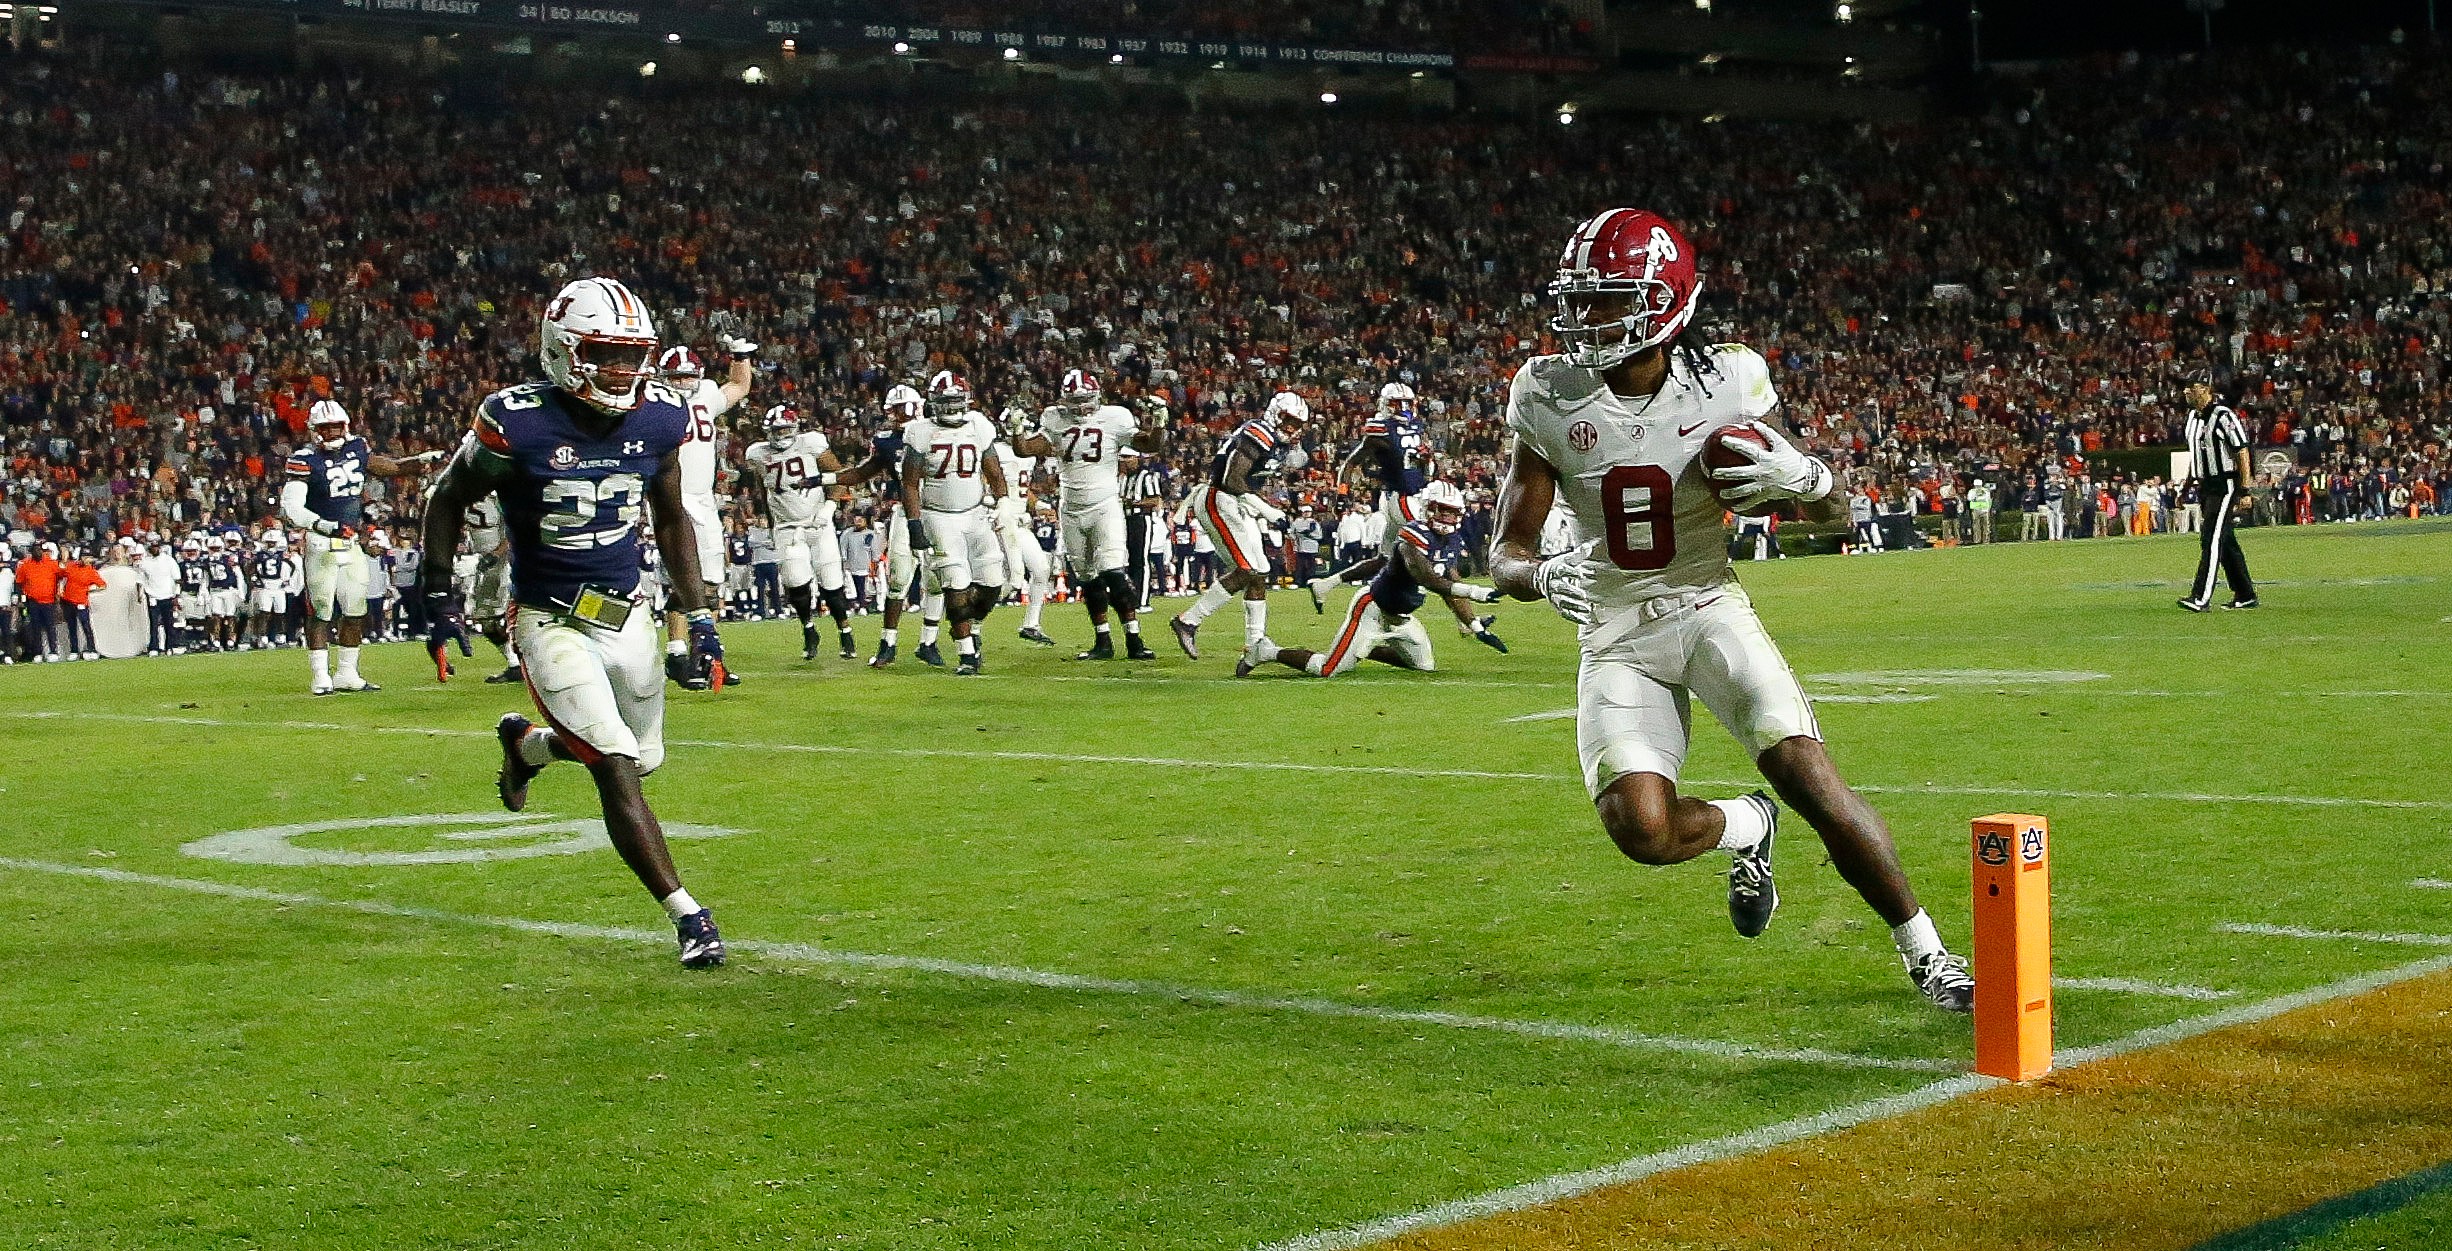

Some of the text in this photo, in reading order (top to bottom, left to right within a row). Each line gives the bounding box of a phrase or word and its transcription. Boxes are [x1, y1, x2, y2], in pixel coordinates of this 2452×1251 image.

[575, 9, 640, 24] JACKSON
[1386, 53, 1453, 66] CHAMPIONS
[1062, 427, 1102, 462] 73
[1569, 421, 1597, 450] SEC
[326, 459, 365, 497] 25
[765, 456, 805, 494] 79
[930, 444, 976, 479] 70
[540, 473, 644, 550] 23
[1601, 464, 1677, 570] 8
[2021, 827, 2044, 861] AU
